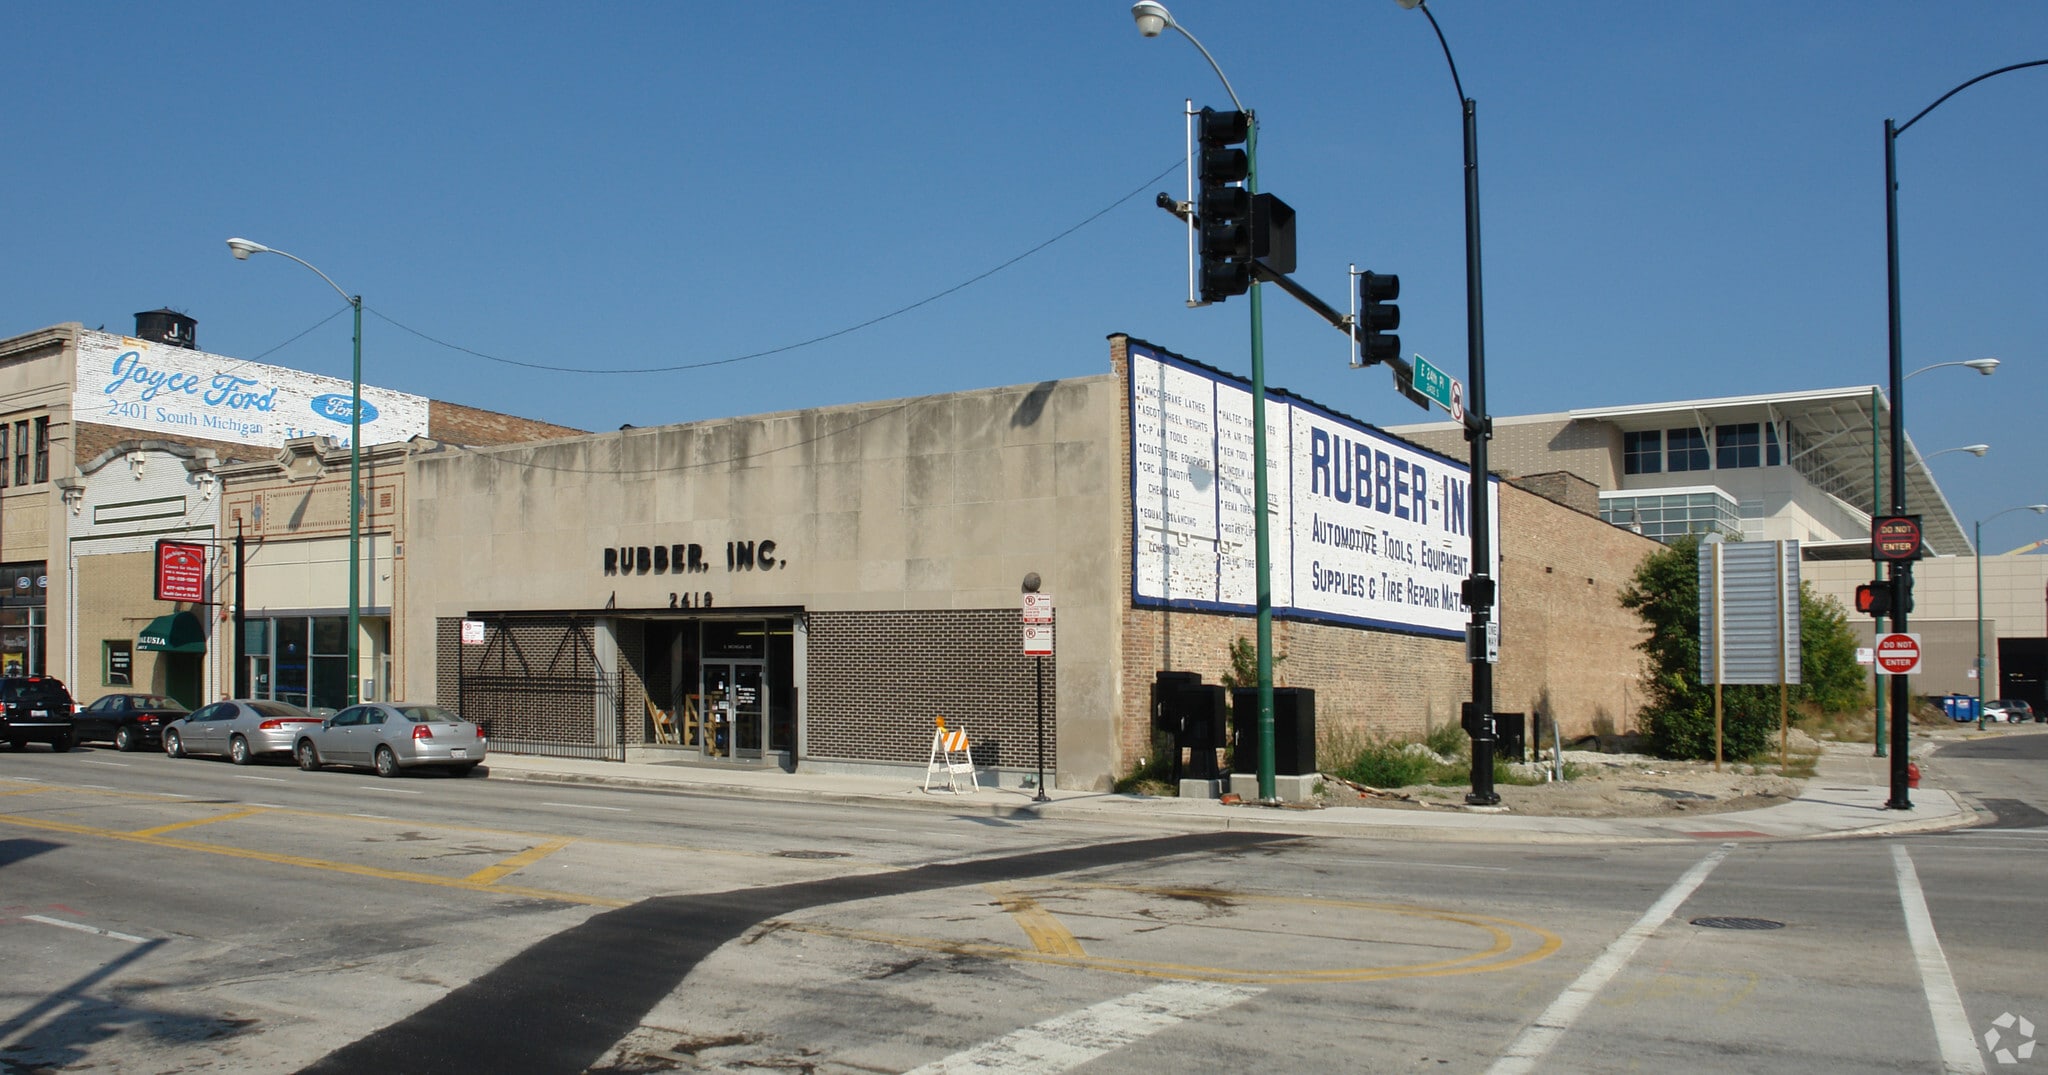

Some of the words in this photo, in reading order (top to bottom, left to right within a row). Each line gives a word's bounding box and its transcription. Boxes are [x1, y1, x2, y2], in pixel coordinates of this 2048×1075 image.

[1421, 363, 1425, 377] E
[104, 351, 199, 401] Joyce
[203, 374, 278, 412] Ford
[1164, 392, 1182, 406] BRAKE
[1185, 398, 1206, 413] LATHES
[108, 400, 148, 420] 2401
[156, 407, 197, 426] South
[203, 414, 263, 437] Michigan
[1143, 406, 1160, 418] ASCOT
[1169, 431, 1187, 444] TOOLS
[1143, 444, 1162, 456] COATS
[1165, 449, 1178, 461] TIRE
[1181, 453, 1210, 469] EQUIPMENT
[1143, 463, 1155, 473] CRC
[1159, 467, 1192, 482] AUTOMOTIVE
[1148, 483, 1180, 499] CHEMICALS
[1144, 508, 1163, 521] EQUAL
[1881, 526, 1893, 534] DO
[1894, 525, 1912, 534] NOT
[1312, 512, 1377, 555] AUTOMOTIVE
[1382, 530, 1417, 569] TOOLS,
[1882, 542, 1912, 551] ENTER
[1312, 561, 1364, 599] SUPPLIES
[1368, 577, 1376, 599] &
[1381, 572, 1403, 603] TIRE
[1407, 577, 1439, 608] REPAIR
[1487, 625, 1497, 636] ONE
[1488, 636, 1497, 646] WAY
[1883, 641, 1895, 649] DO
[1896, 641, 1913, 649] NOT
[1885, 658, 1911, 667] ENTER
